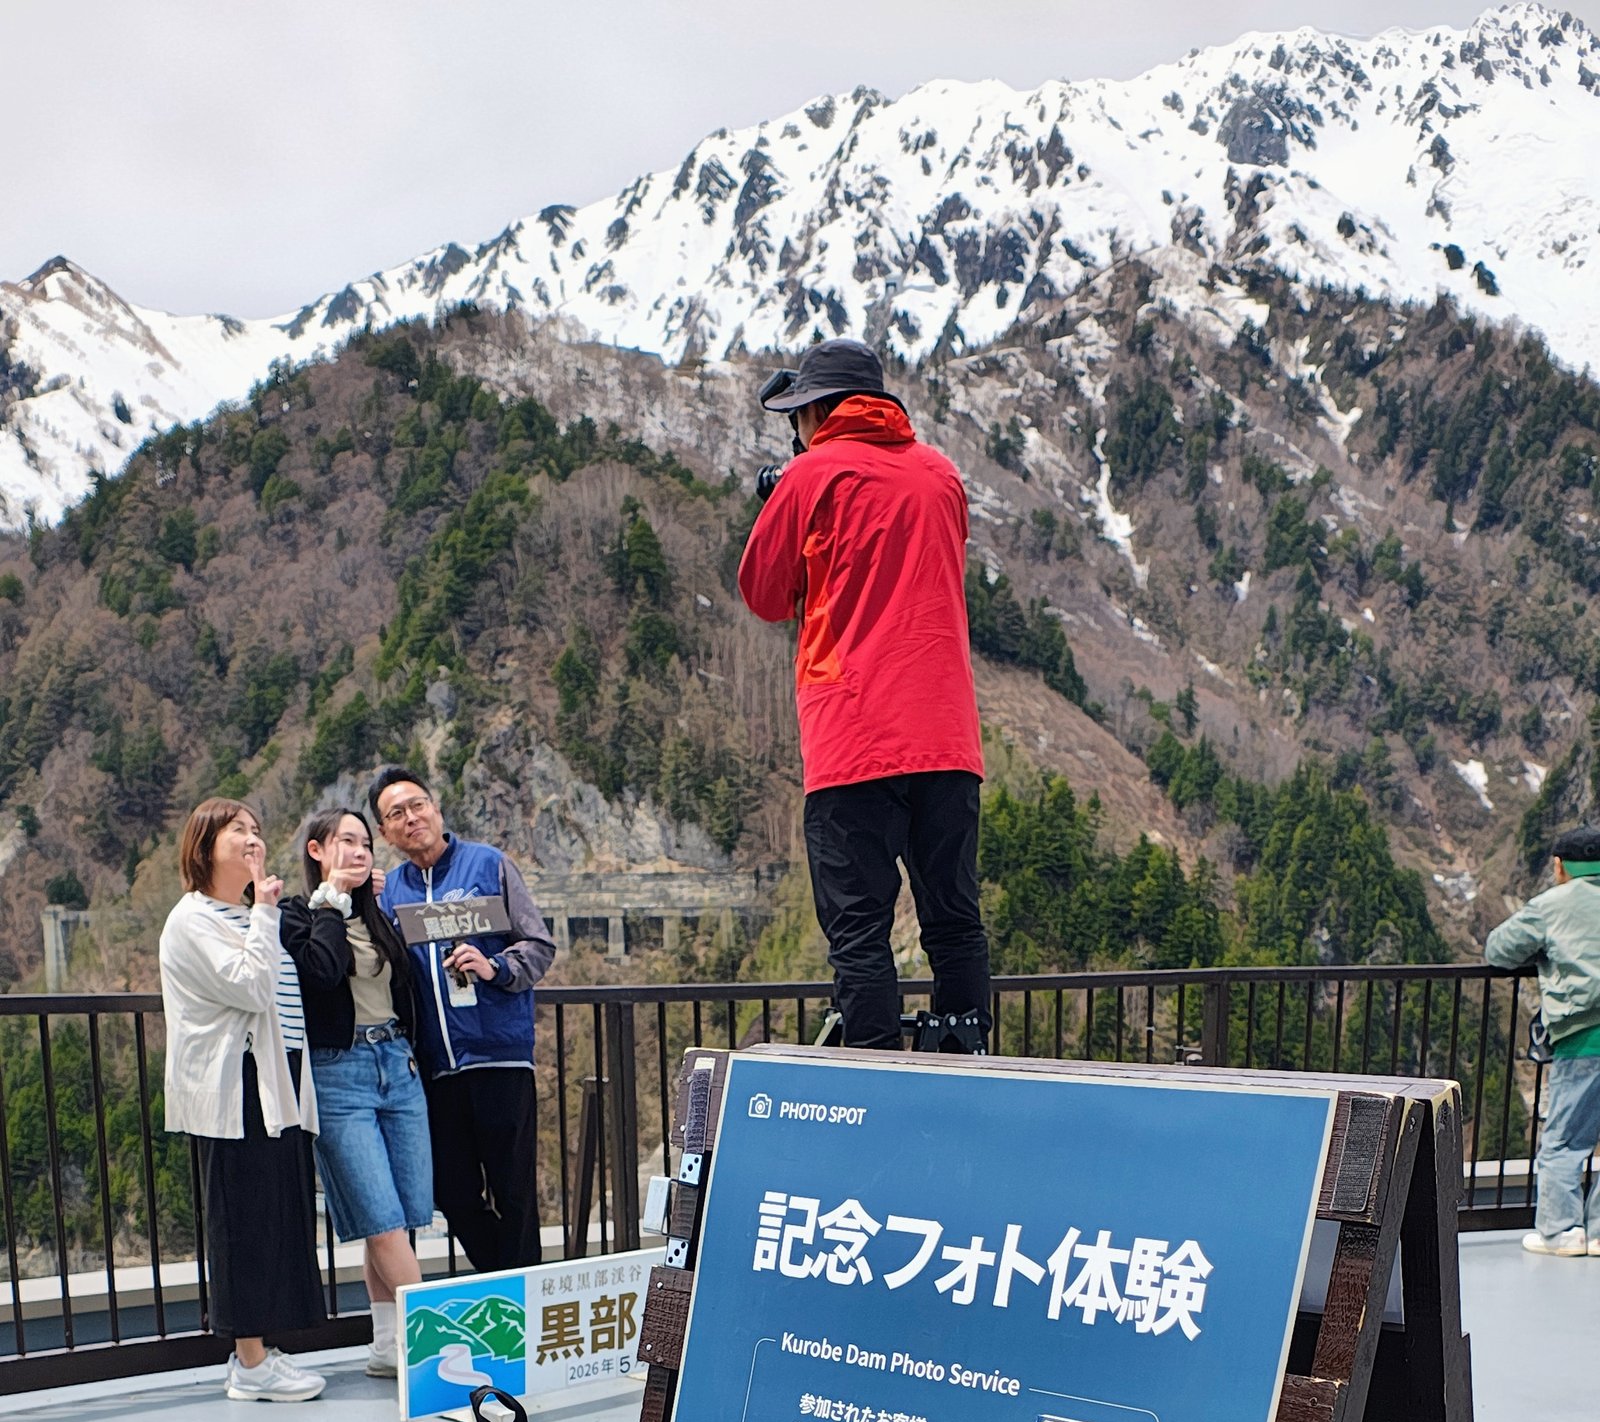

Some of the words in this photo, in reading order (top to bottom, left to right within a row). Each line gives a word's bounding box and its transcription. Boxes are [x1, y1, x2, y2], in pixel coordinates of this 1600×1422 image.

[423, 910, 491, 940] 黒部ダム
[779, 1101, 827, 1122] PHOTO
[828, 1105, 867, 1125] SPOT
[752, 1190, 1214, 1341] 記念フォト体験
[536, 1291, 643, 1366] 黒部
[781, 1331, 843, 1362] Kurobe
[845, 1343, 887, 1370] Dam
[890, 1352, 945, 1382] Photo
[948, 1363, 1020, 1396] Service
